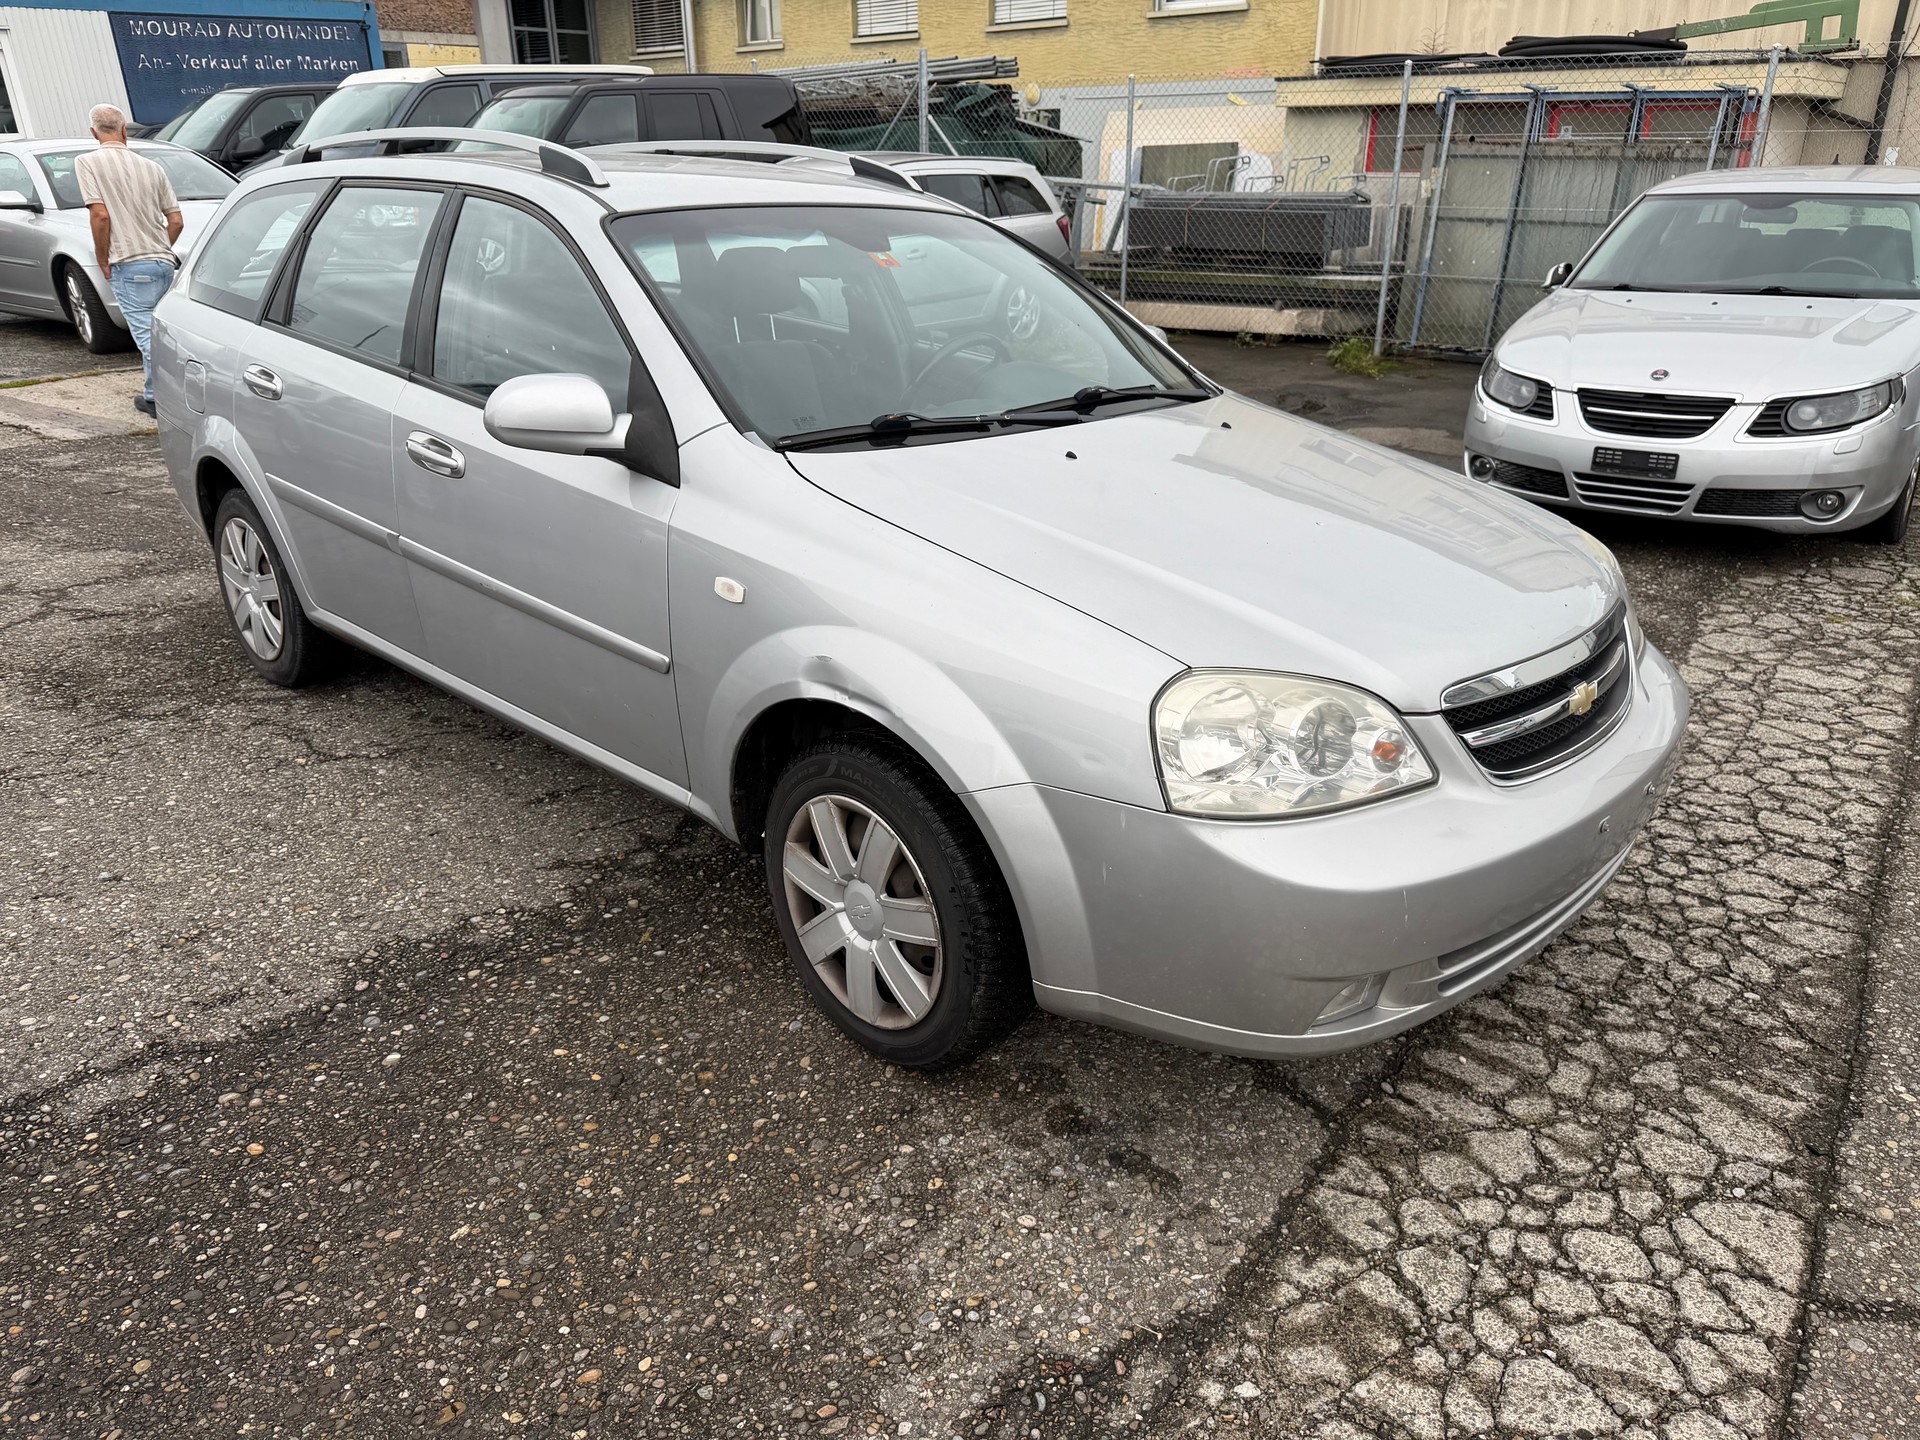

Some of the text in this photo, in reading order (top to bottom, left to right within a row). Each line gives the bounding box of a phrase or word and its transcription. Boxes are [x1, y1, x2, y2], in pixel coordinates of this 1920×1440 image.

[129, 20, 355, 41] MOURAD AUTOHANDEL
[138, 53, 360, 71] An- Verkauf aller Marken
